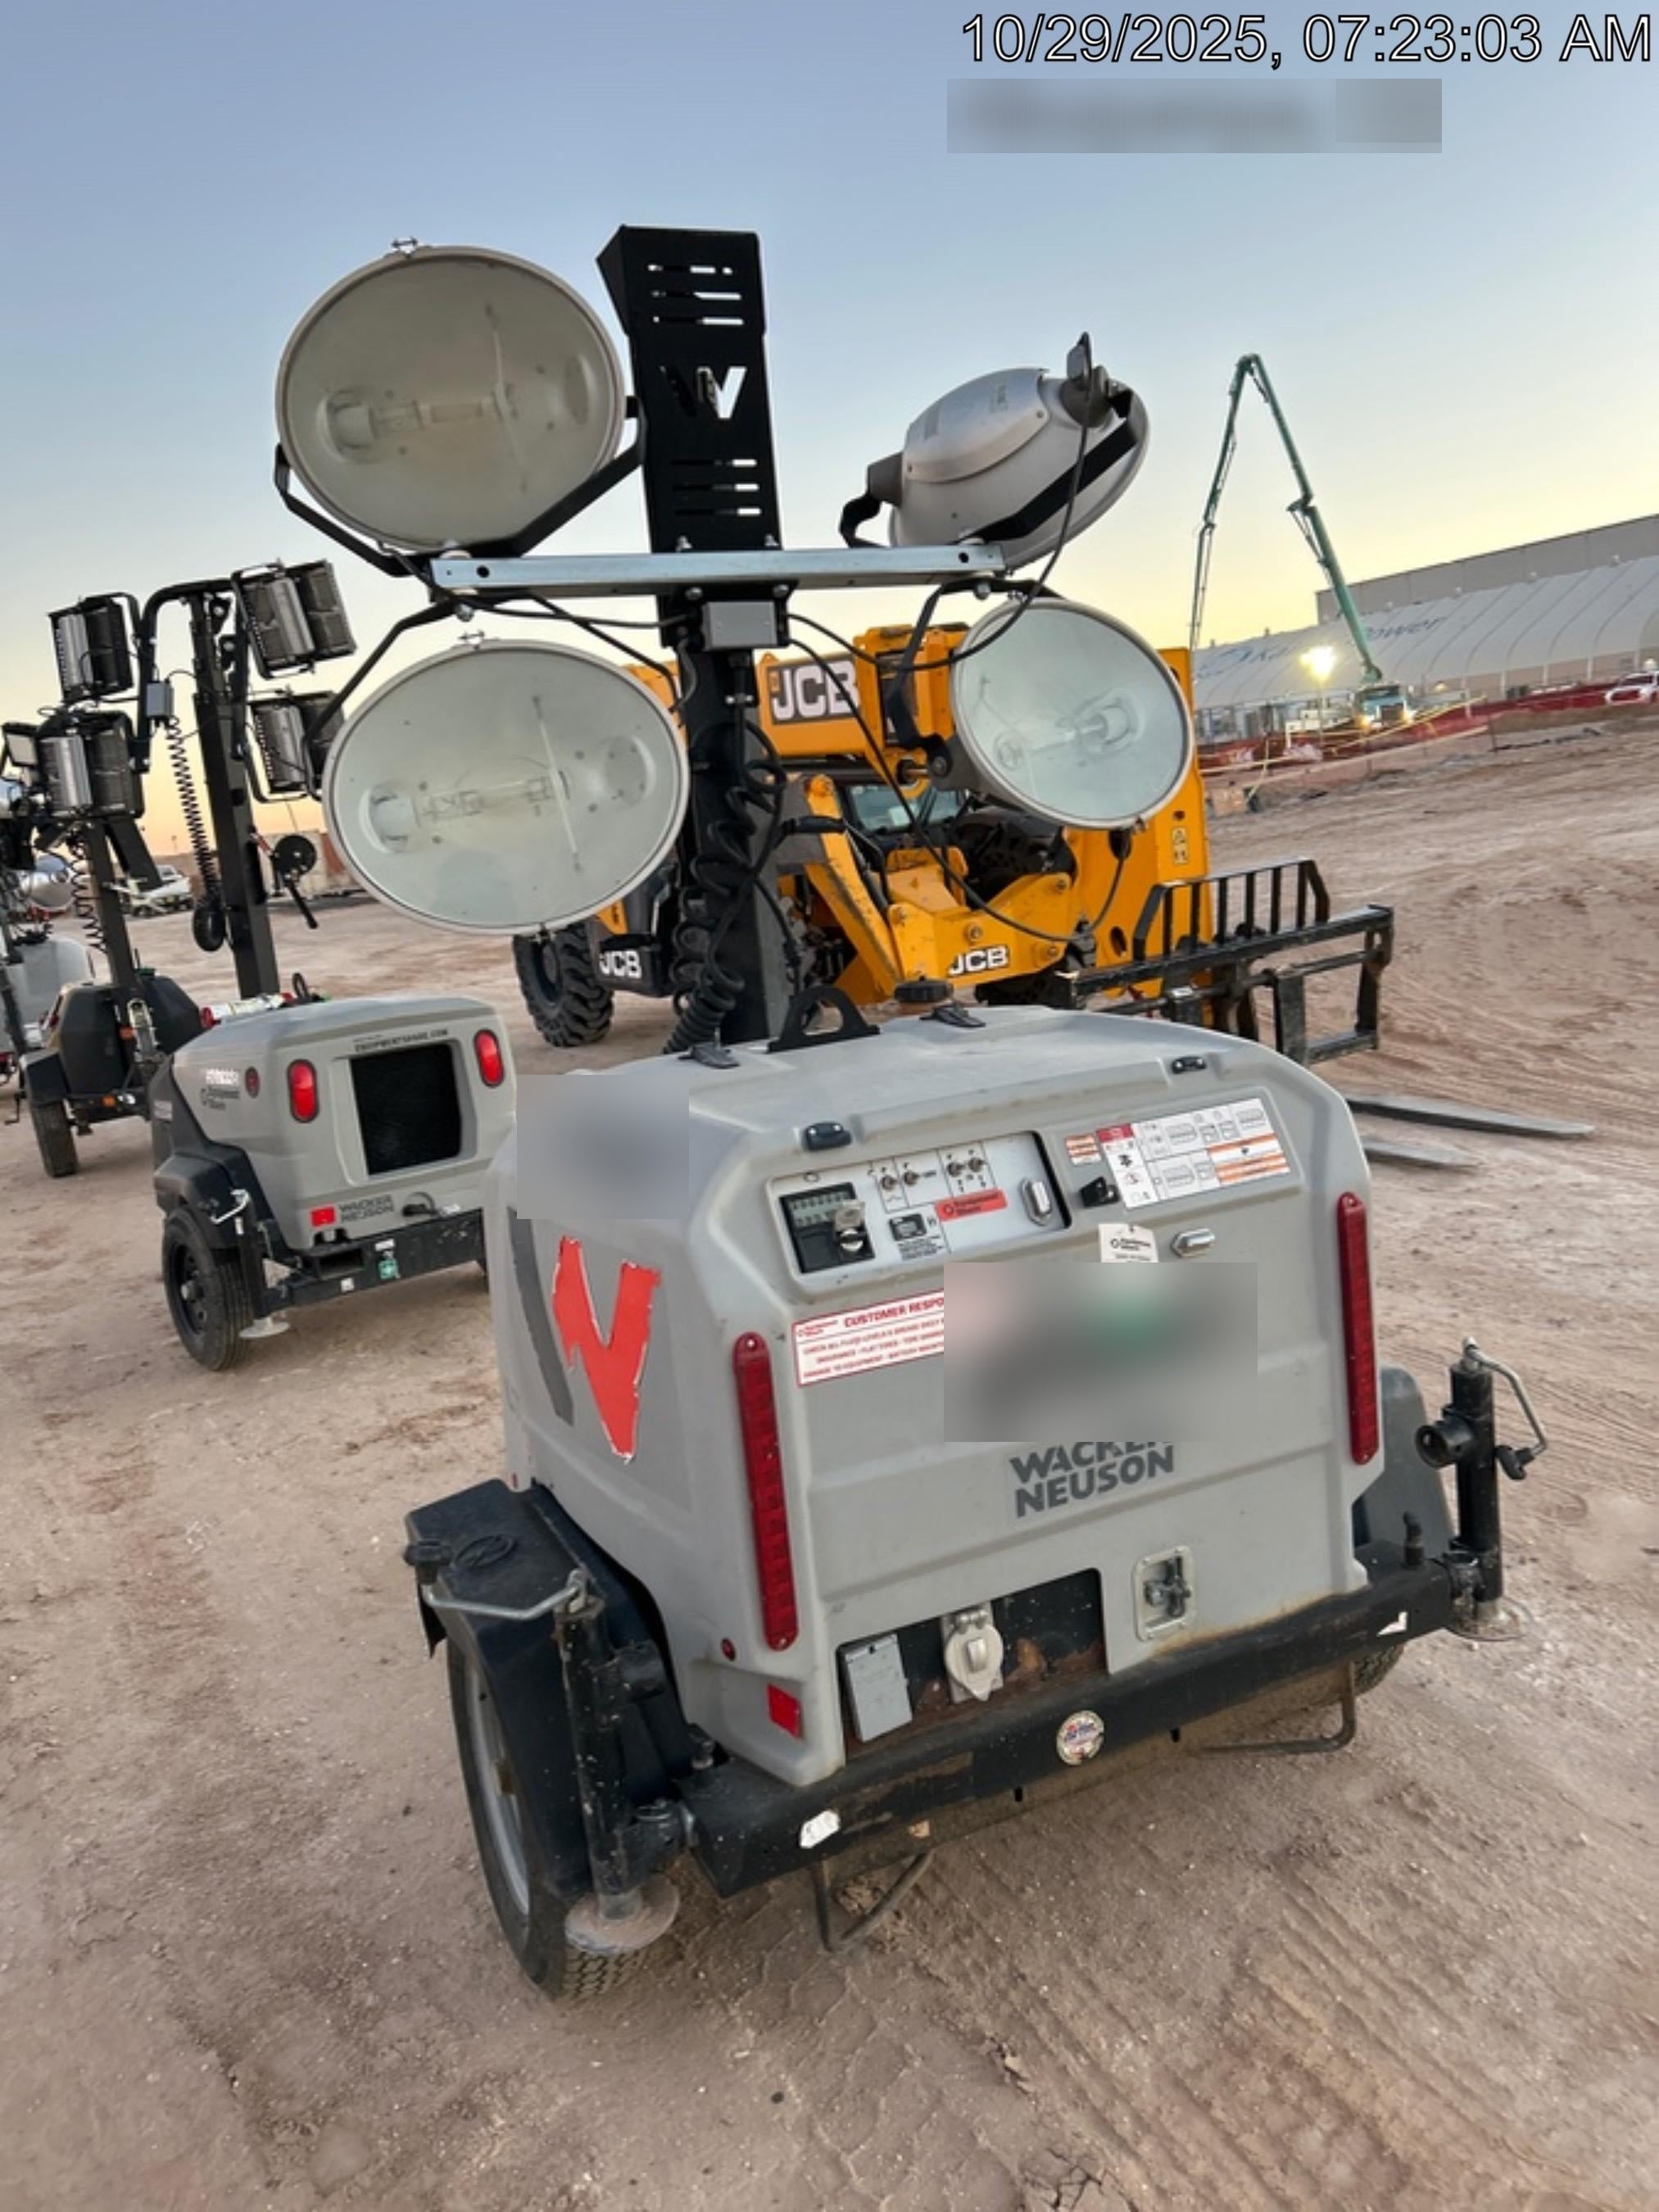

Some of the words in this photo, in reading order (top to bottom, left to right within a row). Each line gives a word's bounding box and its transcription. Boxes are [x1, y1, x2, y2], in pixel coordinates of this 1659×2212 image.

[772, 660, 860, 721] JCB
[599, 950, 642, 980] JCB
[948, 945, 1009, 976] JCB
[845, 1305, 907, 1327] CUSTOMER
[1009, 1442, 1174, 1484] WACK
[1015, 1444, 1175, 1519] NEUSON
